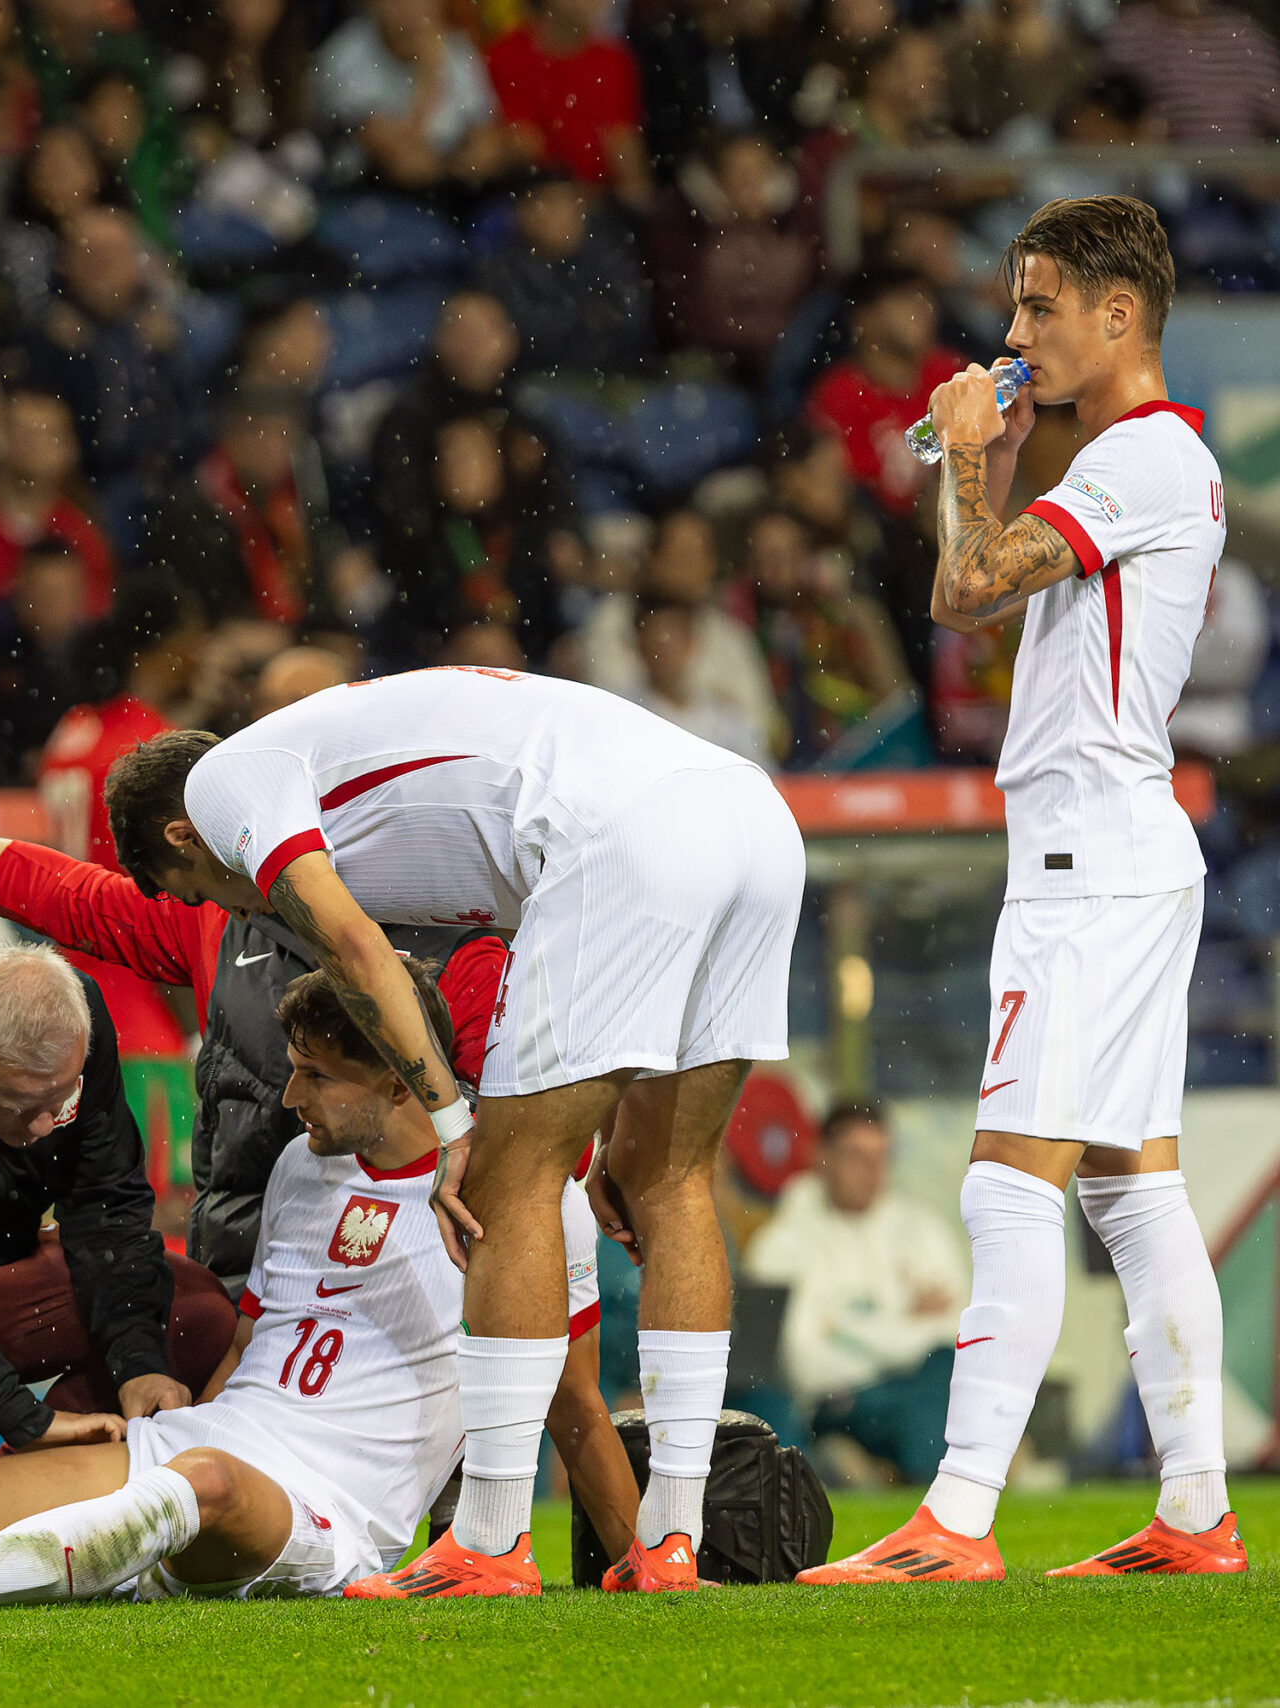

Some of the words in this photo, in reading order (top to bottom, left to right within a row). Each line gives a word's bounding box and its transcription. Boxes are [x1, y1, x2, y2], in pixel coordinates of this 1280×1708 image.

[1066, 477, 1122, 519] FOUNDATION
[991, 988, 1028, 1065] 7
[278, 1317, 344, 1398] 18
